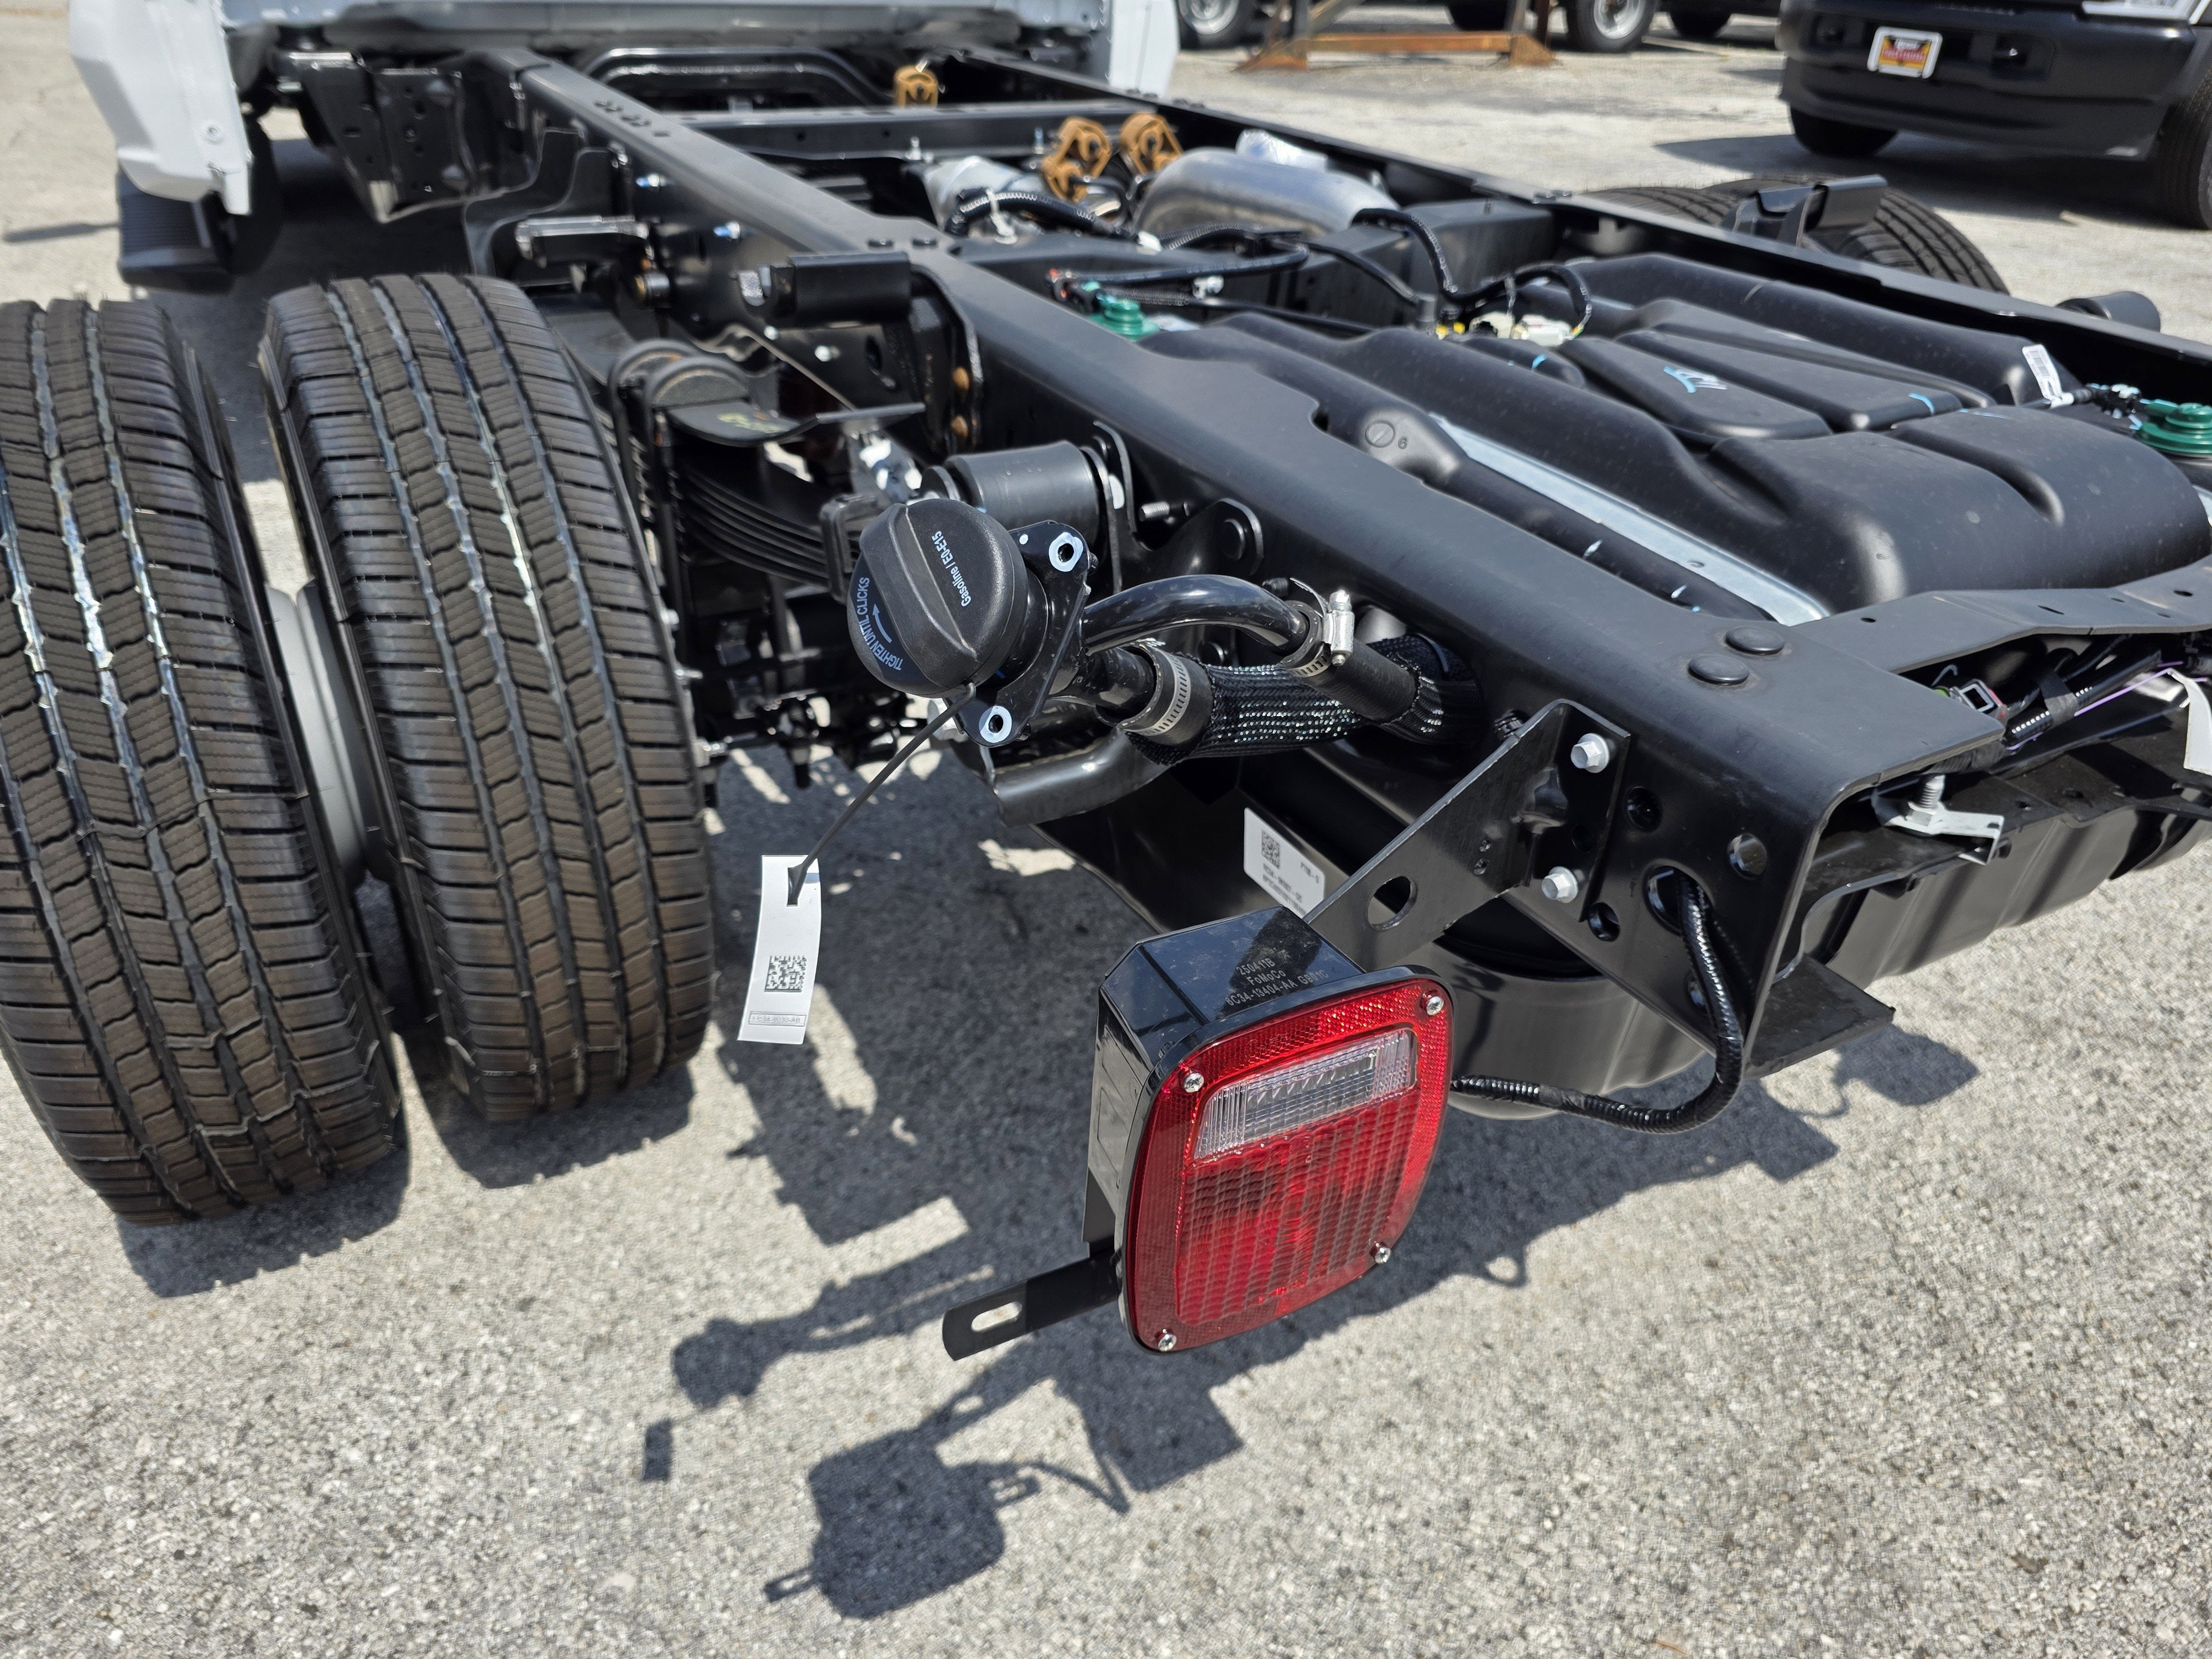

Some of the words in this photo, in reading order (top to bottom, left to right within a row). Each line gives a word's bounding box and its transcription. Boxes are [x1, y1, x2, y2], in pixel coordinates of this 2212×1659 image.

[931, 530, 953, 566] E0-E15
[857, 577, 870, 615] CLICKS
[951, 566, 972, 607] Gasoline
[859, 614, 876, 646] UNTIL
[870, 640, 903, 671] TIGHTEN
[1235, 958, 1276, 975] 250411B
[1246, 970, 1286, 986] FoMoCo
[1297, 969, 1329, 984] G801C
